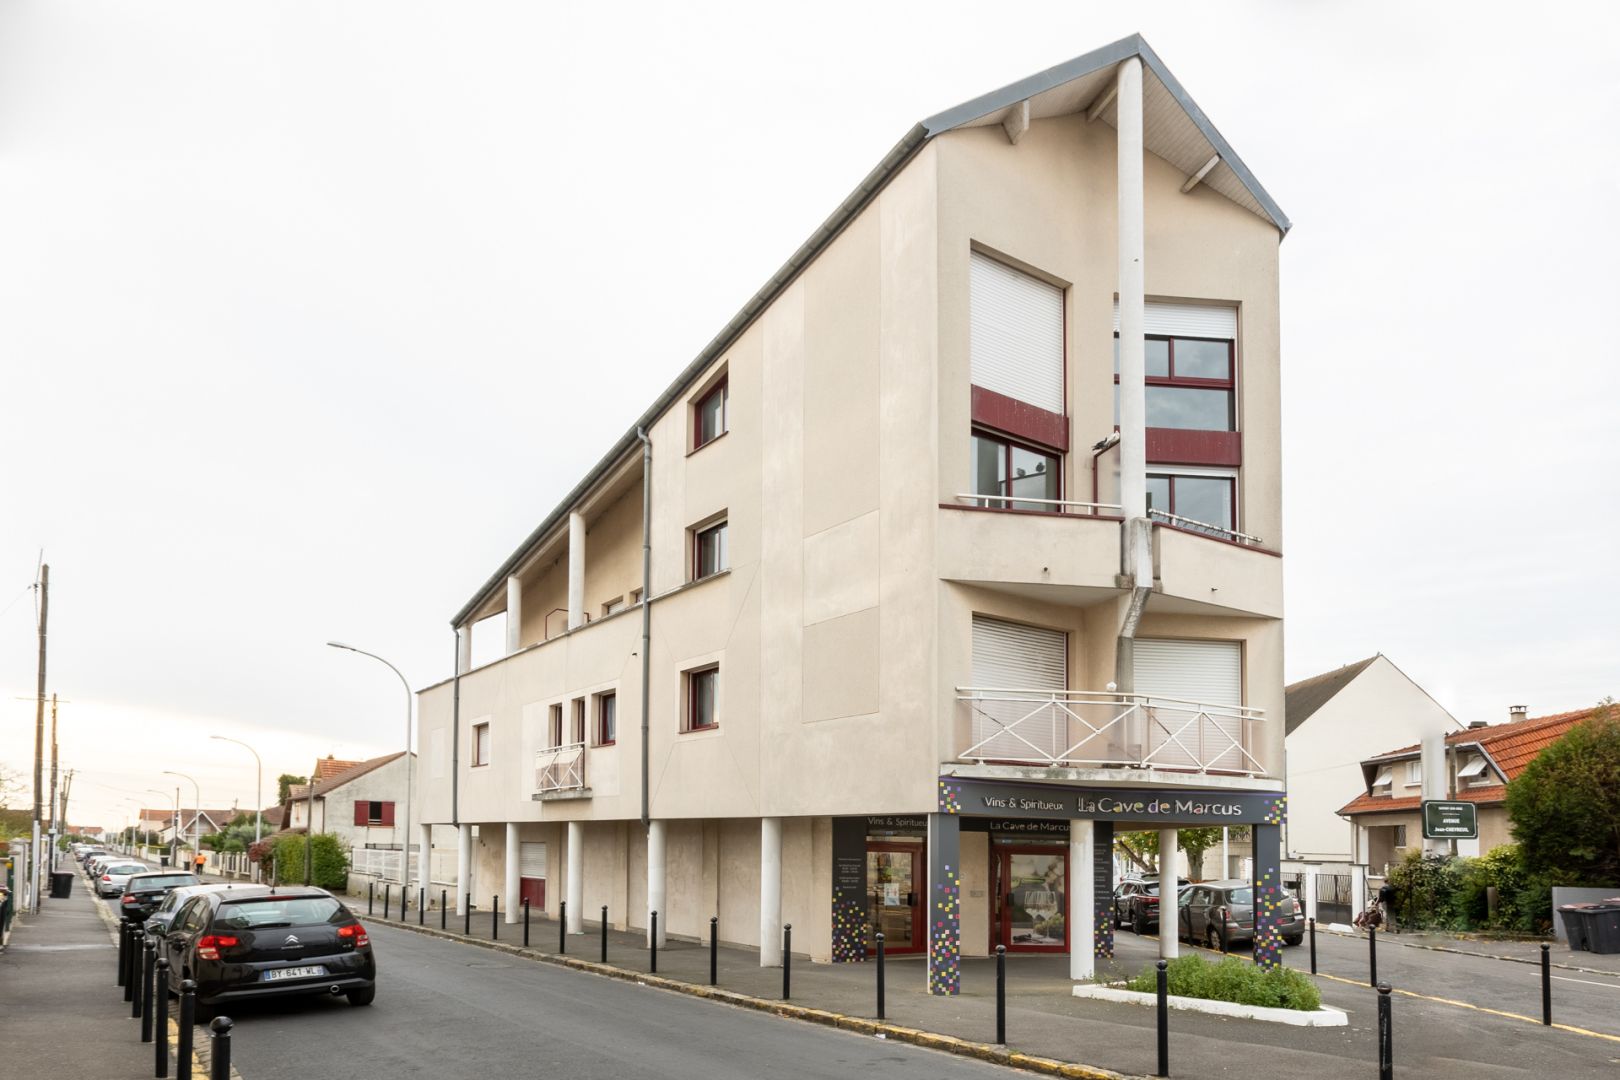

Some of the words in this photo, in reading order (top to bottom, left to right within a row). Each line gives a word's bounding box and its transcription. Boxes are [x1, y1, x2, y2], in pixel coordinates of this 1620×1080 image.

[985, 797, 1005, 808] Vins
[1008, 797, 1017, 808] &
[1020, 798, 1064, 811] Spiritueux
[1078, 797, 1095, 813] La
[1097, 797, 1145, 814] Cave
[1147, 799, 1171, 814] de
[1175, 799, 1242, 815] Marcus
[868, 816, 885, 826] Vins
[886, 817, 893, 826] &
[896, 817, 928, 828] Spiritueu
[990, 821, 1001, 830] La
[1002, 821, 1026, 831] Cave
[1027, 822, 1039, 831] de
[1040, 822, 1071, 832] Marcu
